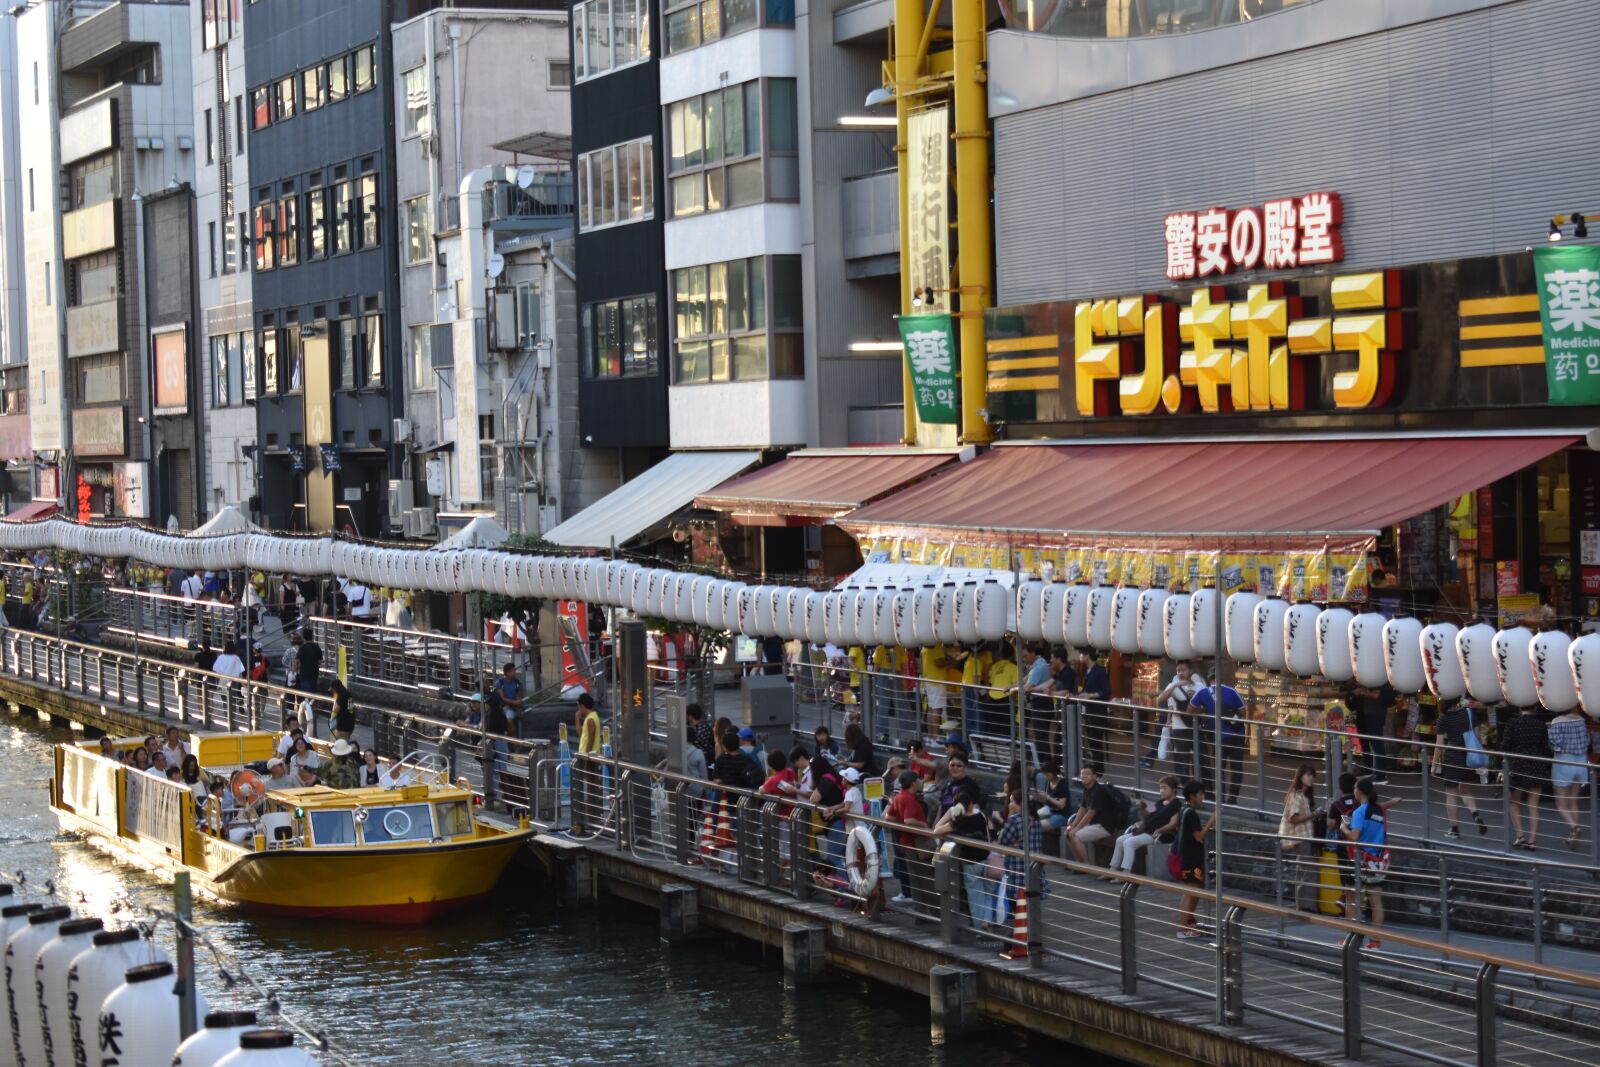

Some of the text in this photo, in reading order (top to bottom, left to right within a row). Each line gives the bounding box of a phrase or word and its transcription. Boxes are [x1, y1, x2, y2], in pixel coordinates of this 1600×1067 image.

[1165, 193, 1337, 279] 驚安の殿堂
[1543, 268, 1600, 332] 薬
[905, 329, 952, 375] 薬
[1550, 337, 1600, 349] Medicin
[914, 376, 953, 387] Medicine
[1553, 352, 1579, 381] 药
